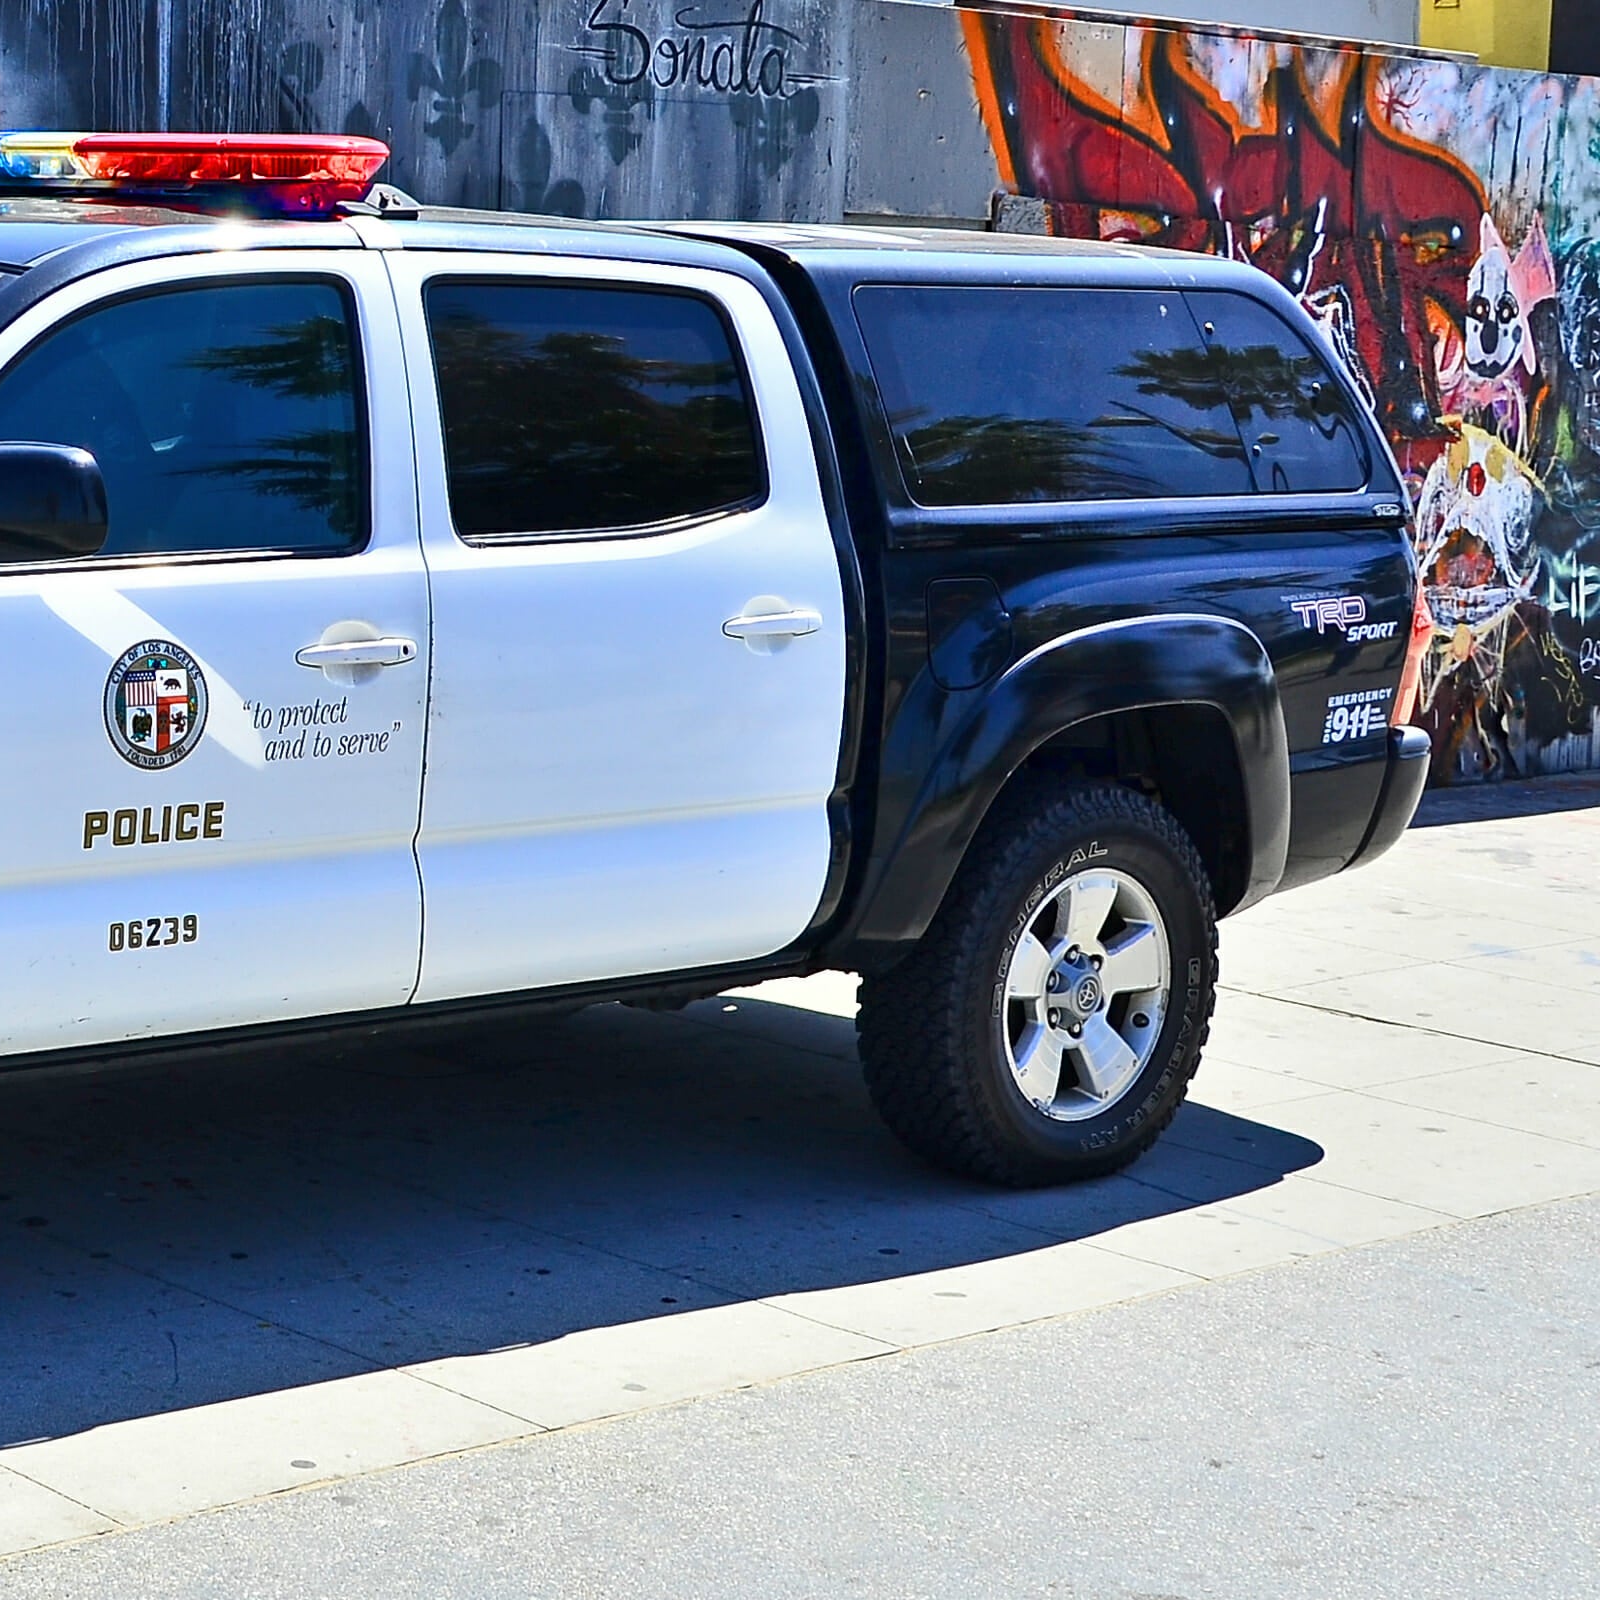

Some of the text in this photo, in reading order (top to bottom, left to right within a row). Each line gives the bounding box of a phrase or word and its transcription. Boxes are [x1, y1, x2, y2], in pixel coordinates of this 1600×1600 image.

[1291, 596, 1366, 634] TRD
[1346, 621, 1398, 642] SPORT
[111, 643, 201, 685] CITY OF LOS ANGELES
[1327, 687, 1393, 708] EMERGENCY
[278, 696, 349, 735] protect
[1322, 711, 1334, 743] DIAL
[125, 748, 166, 766] FOUNDED
[265, 730, 307, 762] and
[312, 731, 332, 758] to
[82, 801, 225, 850] POLICE
[108, 913, 199, 952] 06239
